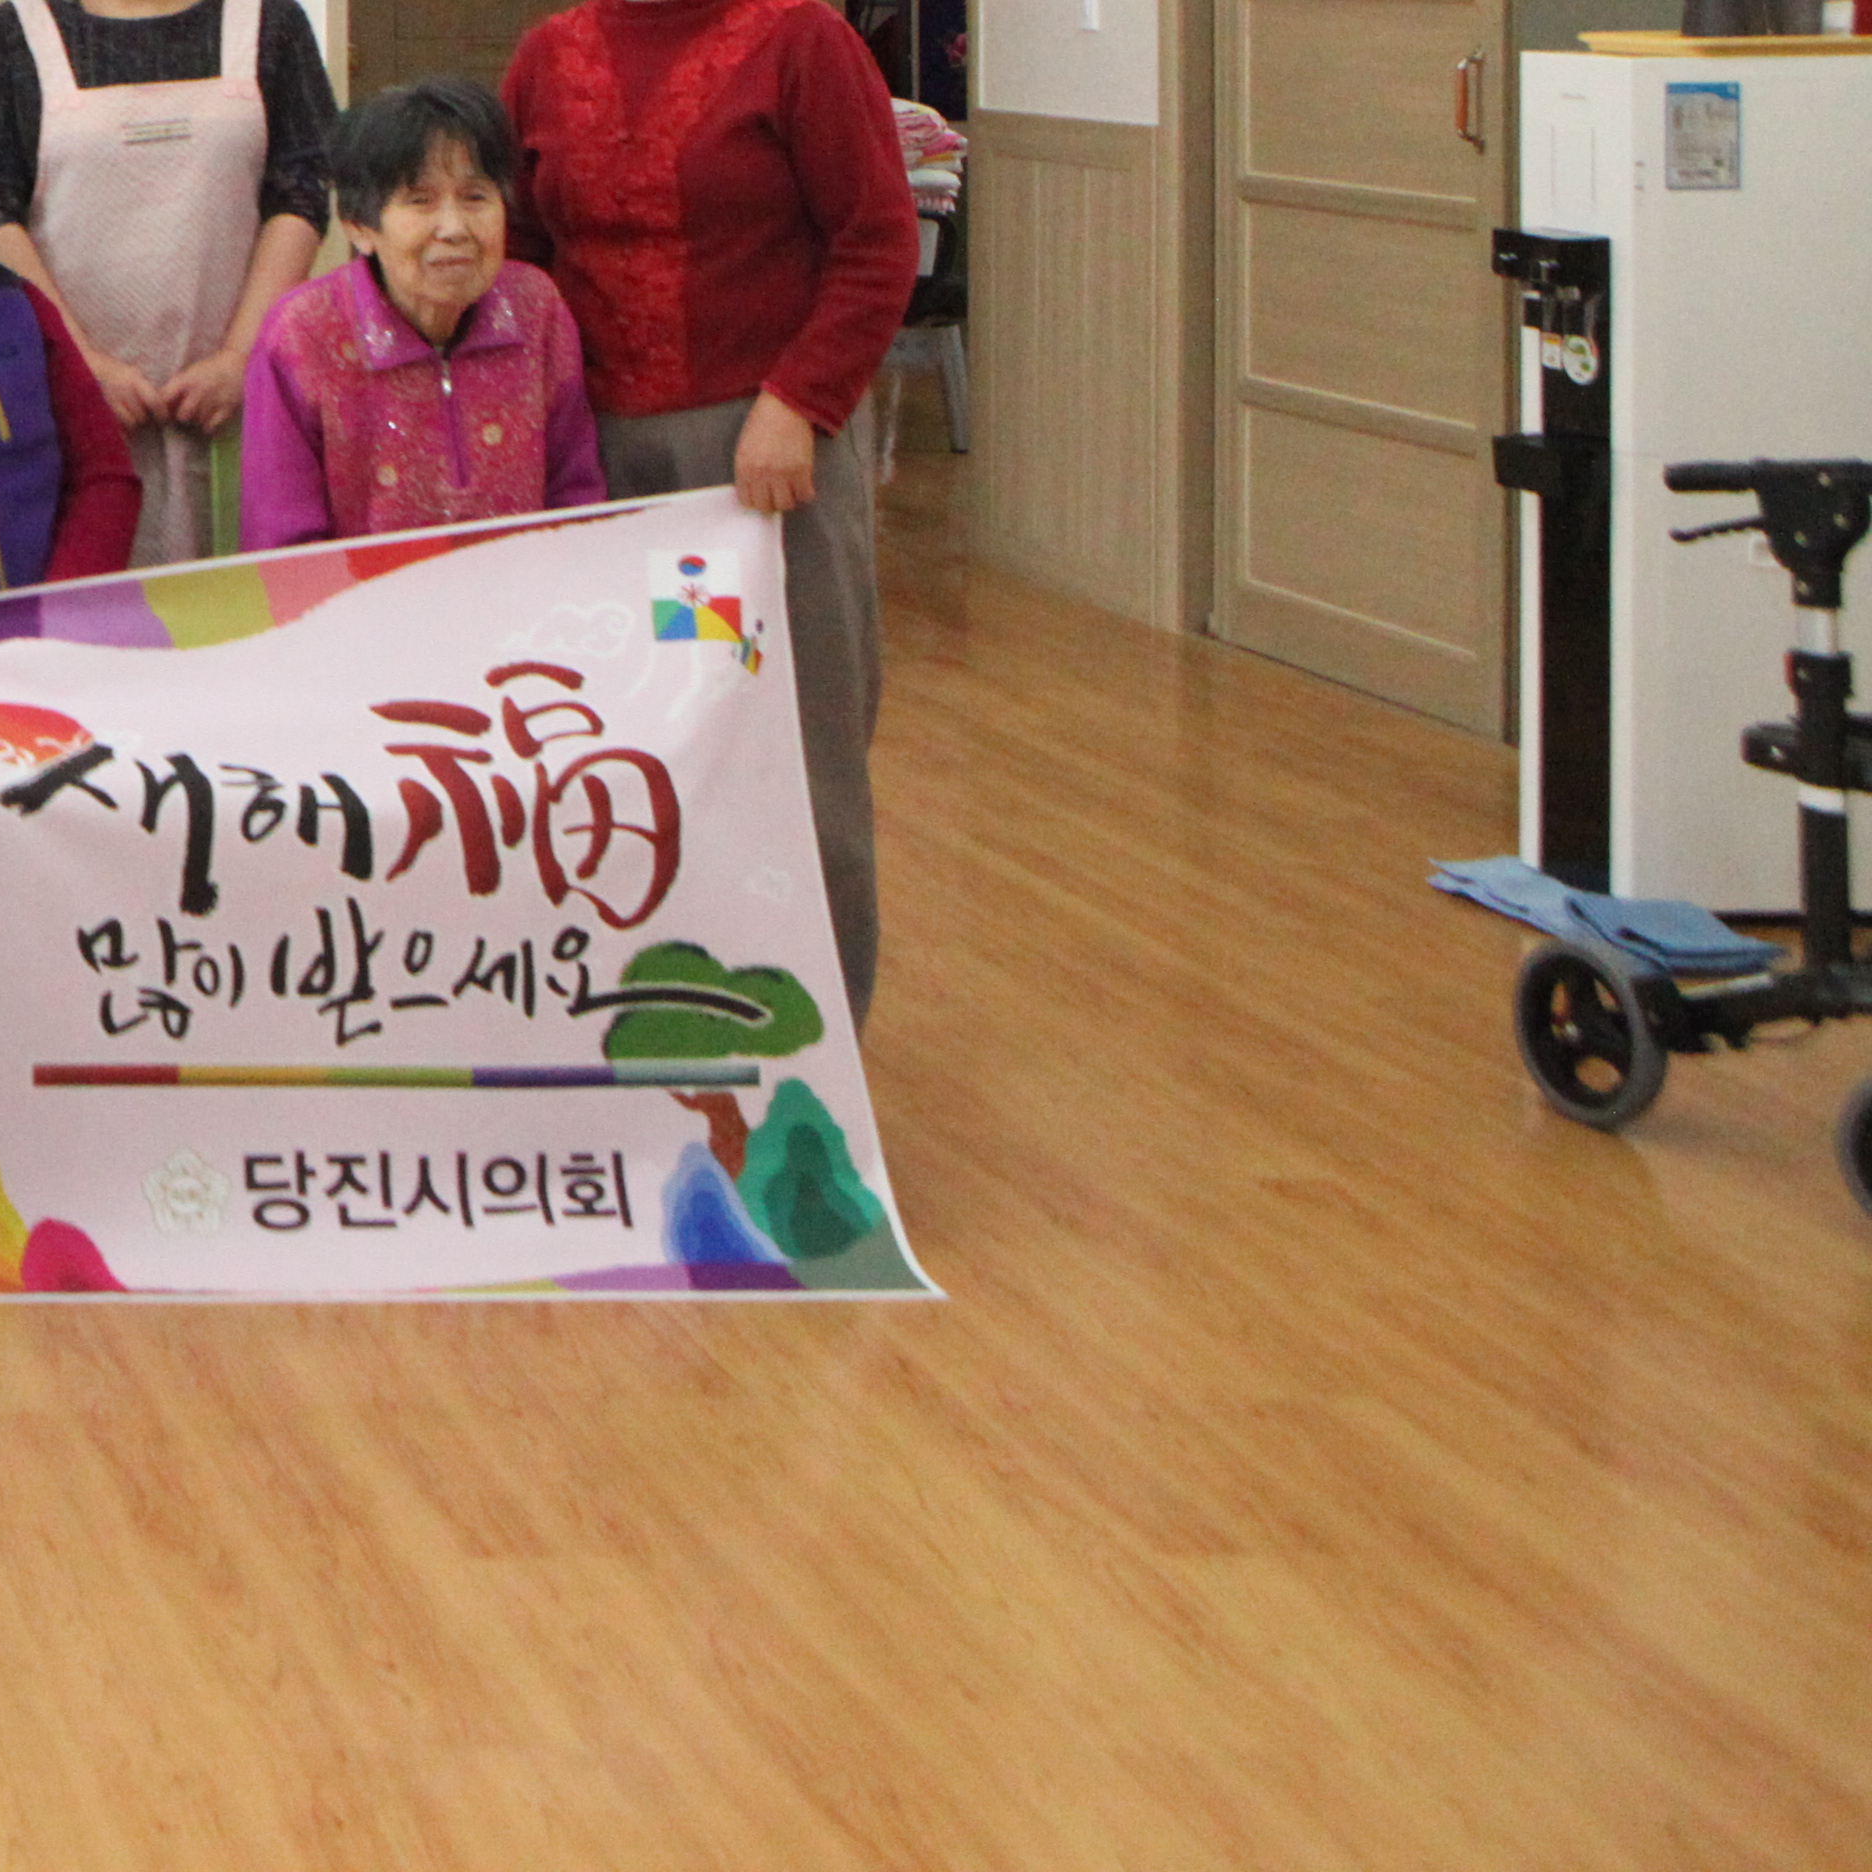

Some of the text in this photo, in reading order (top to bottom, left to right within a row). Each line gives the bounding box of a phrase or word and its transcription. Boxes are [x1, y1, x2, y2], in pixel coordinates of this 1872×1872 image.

[77, 898, 770, 1046] 많이 받으세요
[243, 1149, 635, 1230] 당진시의회
